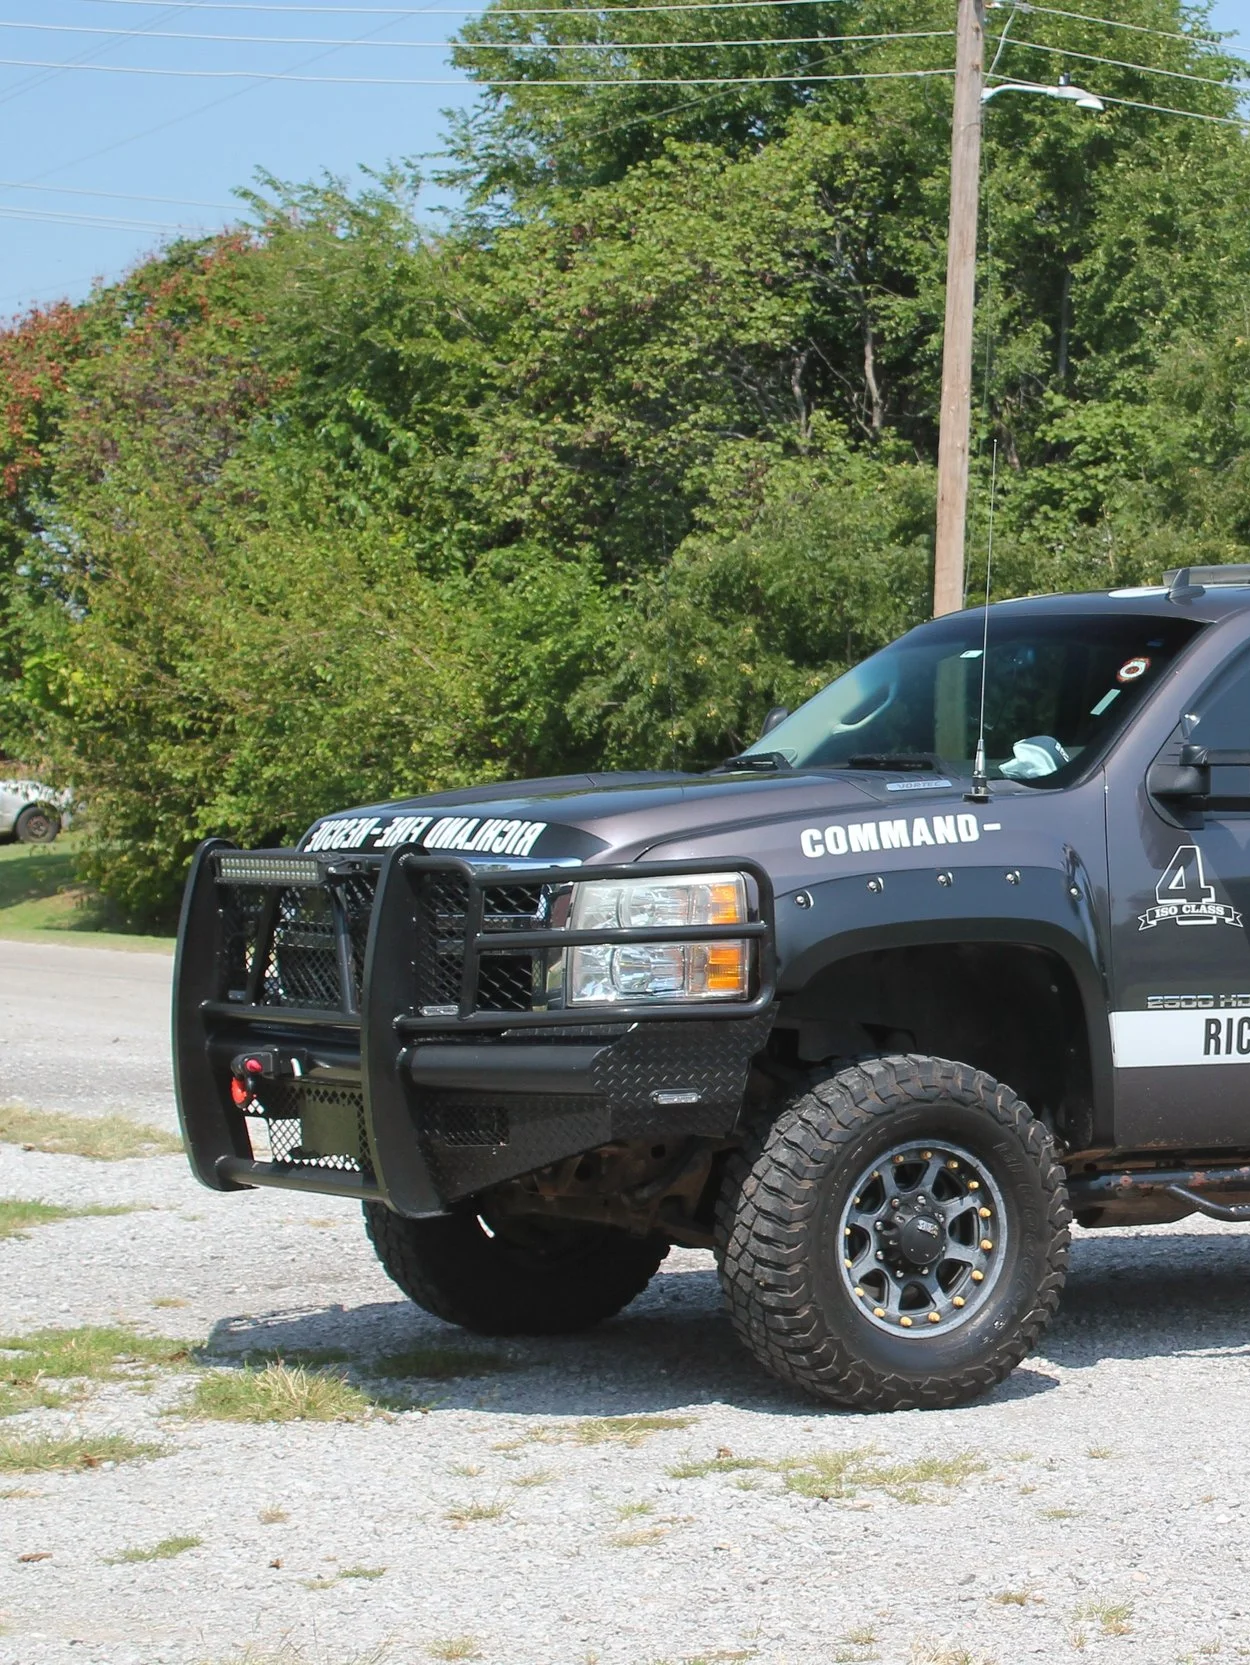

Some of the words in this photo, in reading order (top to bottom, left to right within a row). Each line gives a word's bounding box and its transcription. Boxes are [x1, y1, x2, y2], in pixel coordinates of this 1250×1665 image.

[800, 813, 1002, 858] COMMAND-
[1155, 845, 1216, 925] 4
[1154, 906, 1178, 918] ISO
[1182, 904, 1225, 916] CLASS
[1147, 994, 1214, 1009] 2500
